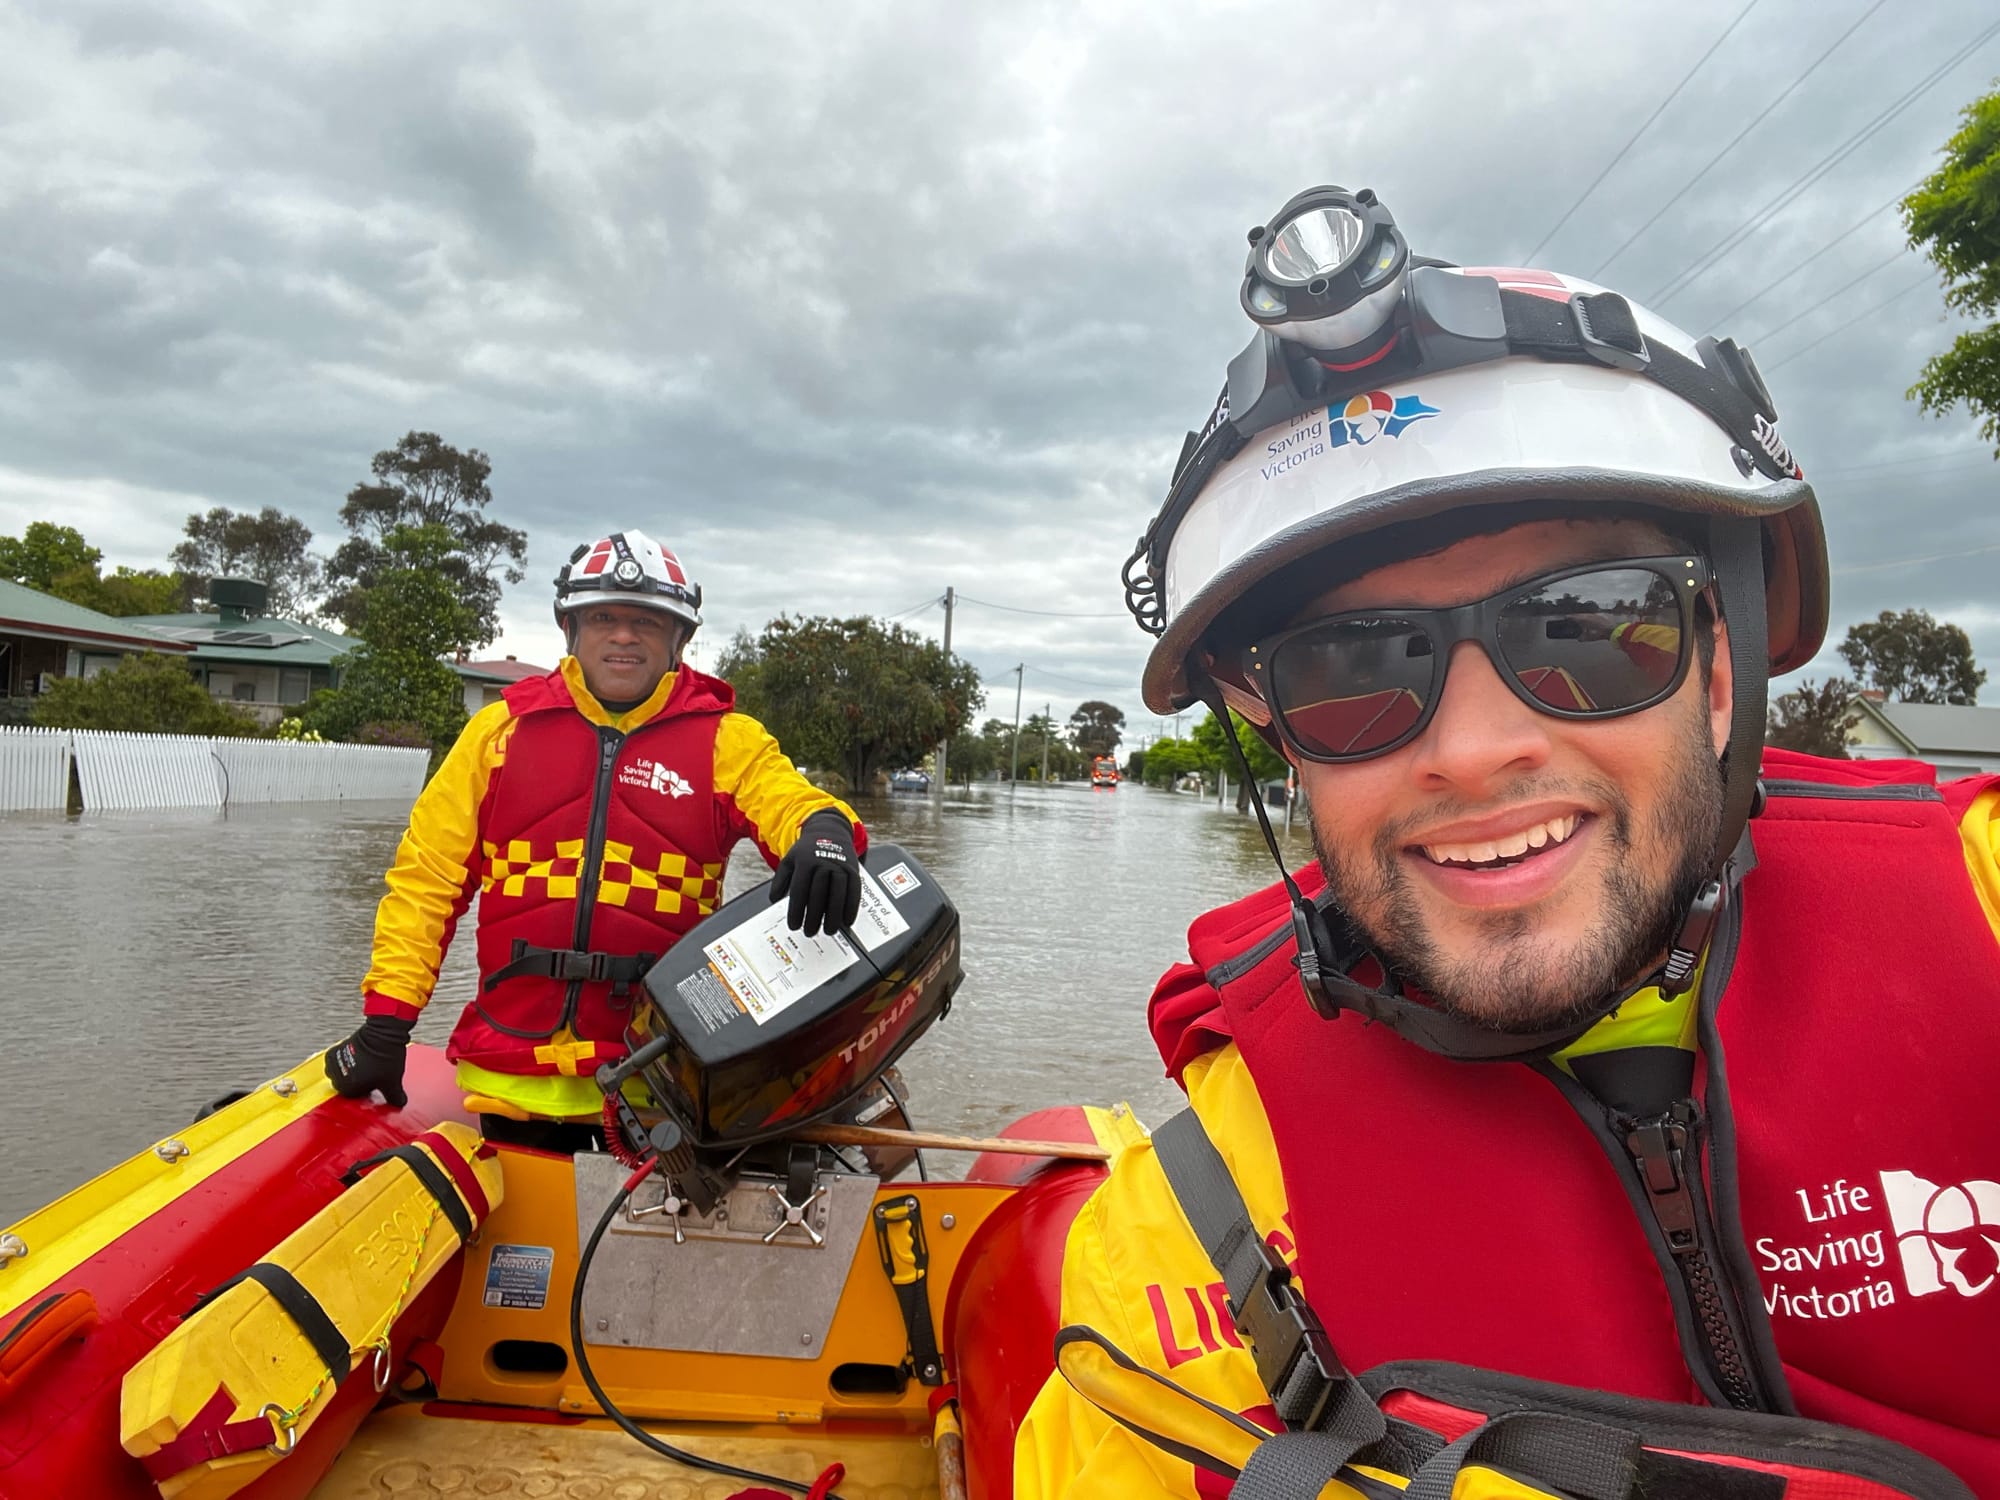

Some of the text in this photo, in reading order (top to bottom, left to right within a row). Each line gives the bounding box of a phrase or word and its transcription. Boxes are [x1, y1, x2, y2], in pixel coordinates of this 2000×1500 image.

[1267, 421, 1323, 459] Saving
[1261, 442, 1324, 480] Victoria
[624, 765, 651, 779] Saving
[637, 758, 653, 769] Life
[619, 774, 649, 788] Victoria
[815, 850, 847, 861] mares
[867, 906, 890, 936] Victoria
[880, 907, 892, 916] of
[838, 938, 955, 1064] TOHATSU
[1796, 1179, 1872, 1223] Life
[1756, 1230, 1885, 1272] Saving
[1763, 1276, 1895, 1319] Victoria
